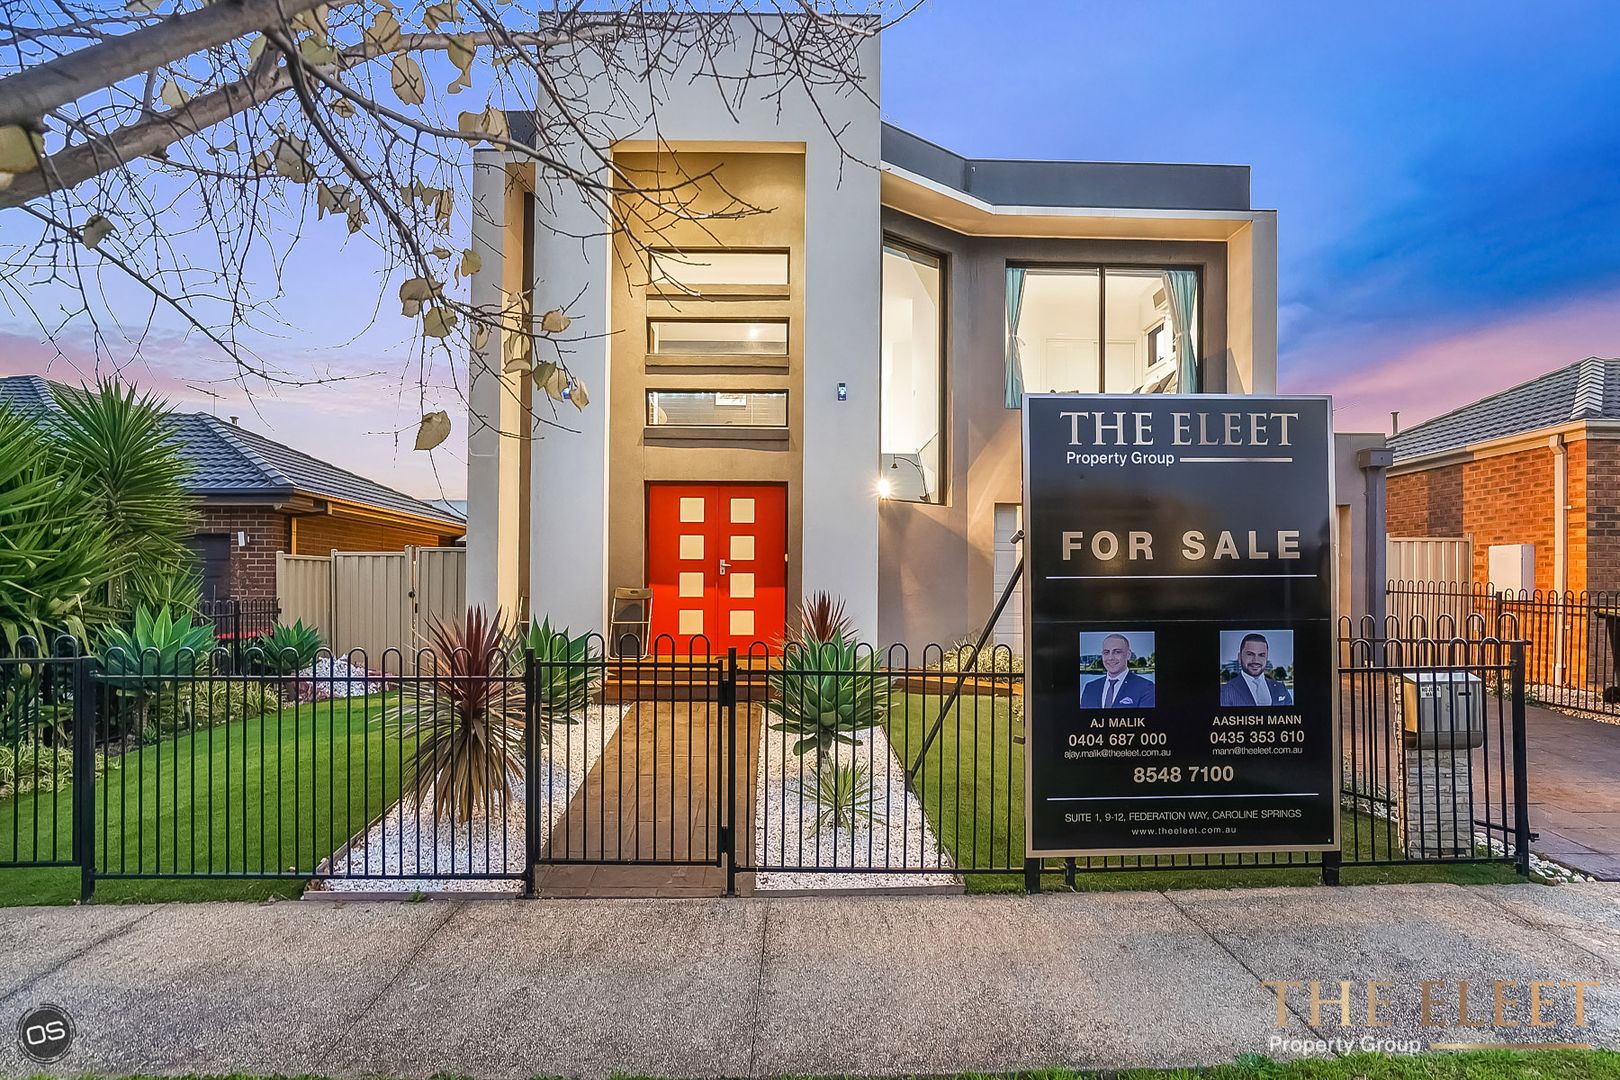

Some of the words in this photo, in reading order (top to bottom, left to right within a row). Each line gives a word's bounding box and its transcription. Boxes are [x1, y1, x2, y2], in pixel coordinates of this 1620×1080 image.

[1060, 412, 1153, 445] THE
[1170, 413, 1298, 445] ELEET
[1066, 451, 1128, 467] Property
[1130, 451, 1175, 467] Group
[1063, 531, 1153, 560] FOR
[1182, 531, 1299, 560] SALE
[1089, 718, 1105, 728] AJ
[1108, 717, 1146, 728] MALIK
[1212, 715, 1264, 726] AASHISH
[1267, 714, 1302, 725] MANN
[1068, 733, 1104, 747] 0404
[1109, 733, 1135, 746] 687
[1140, 732, 1167, 746] 000
[1209, 731, 1245, 744] 0435
[1249, 730, 1276, 744] 353
[1280, 730, 1305, 743] 610
[1212, 746, 1303, 756] mann@theeleet.com.au
[1133, 766, 1182, 784] 8548
[1188, 765, 1234, 782] 7100
[1064, 812, 1092, 823] SUITE
[1128, 811, 1186, 821] FEDERATION
[1187, 811, 1210, 821] WAY,
[1212, 809, 1259, 820] CAROLINE
[1260, 808, 1302, 819] SPRINGS
[1131, 826, 1237, 836] www.theeleet.com.au
